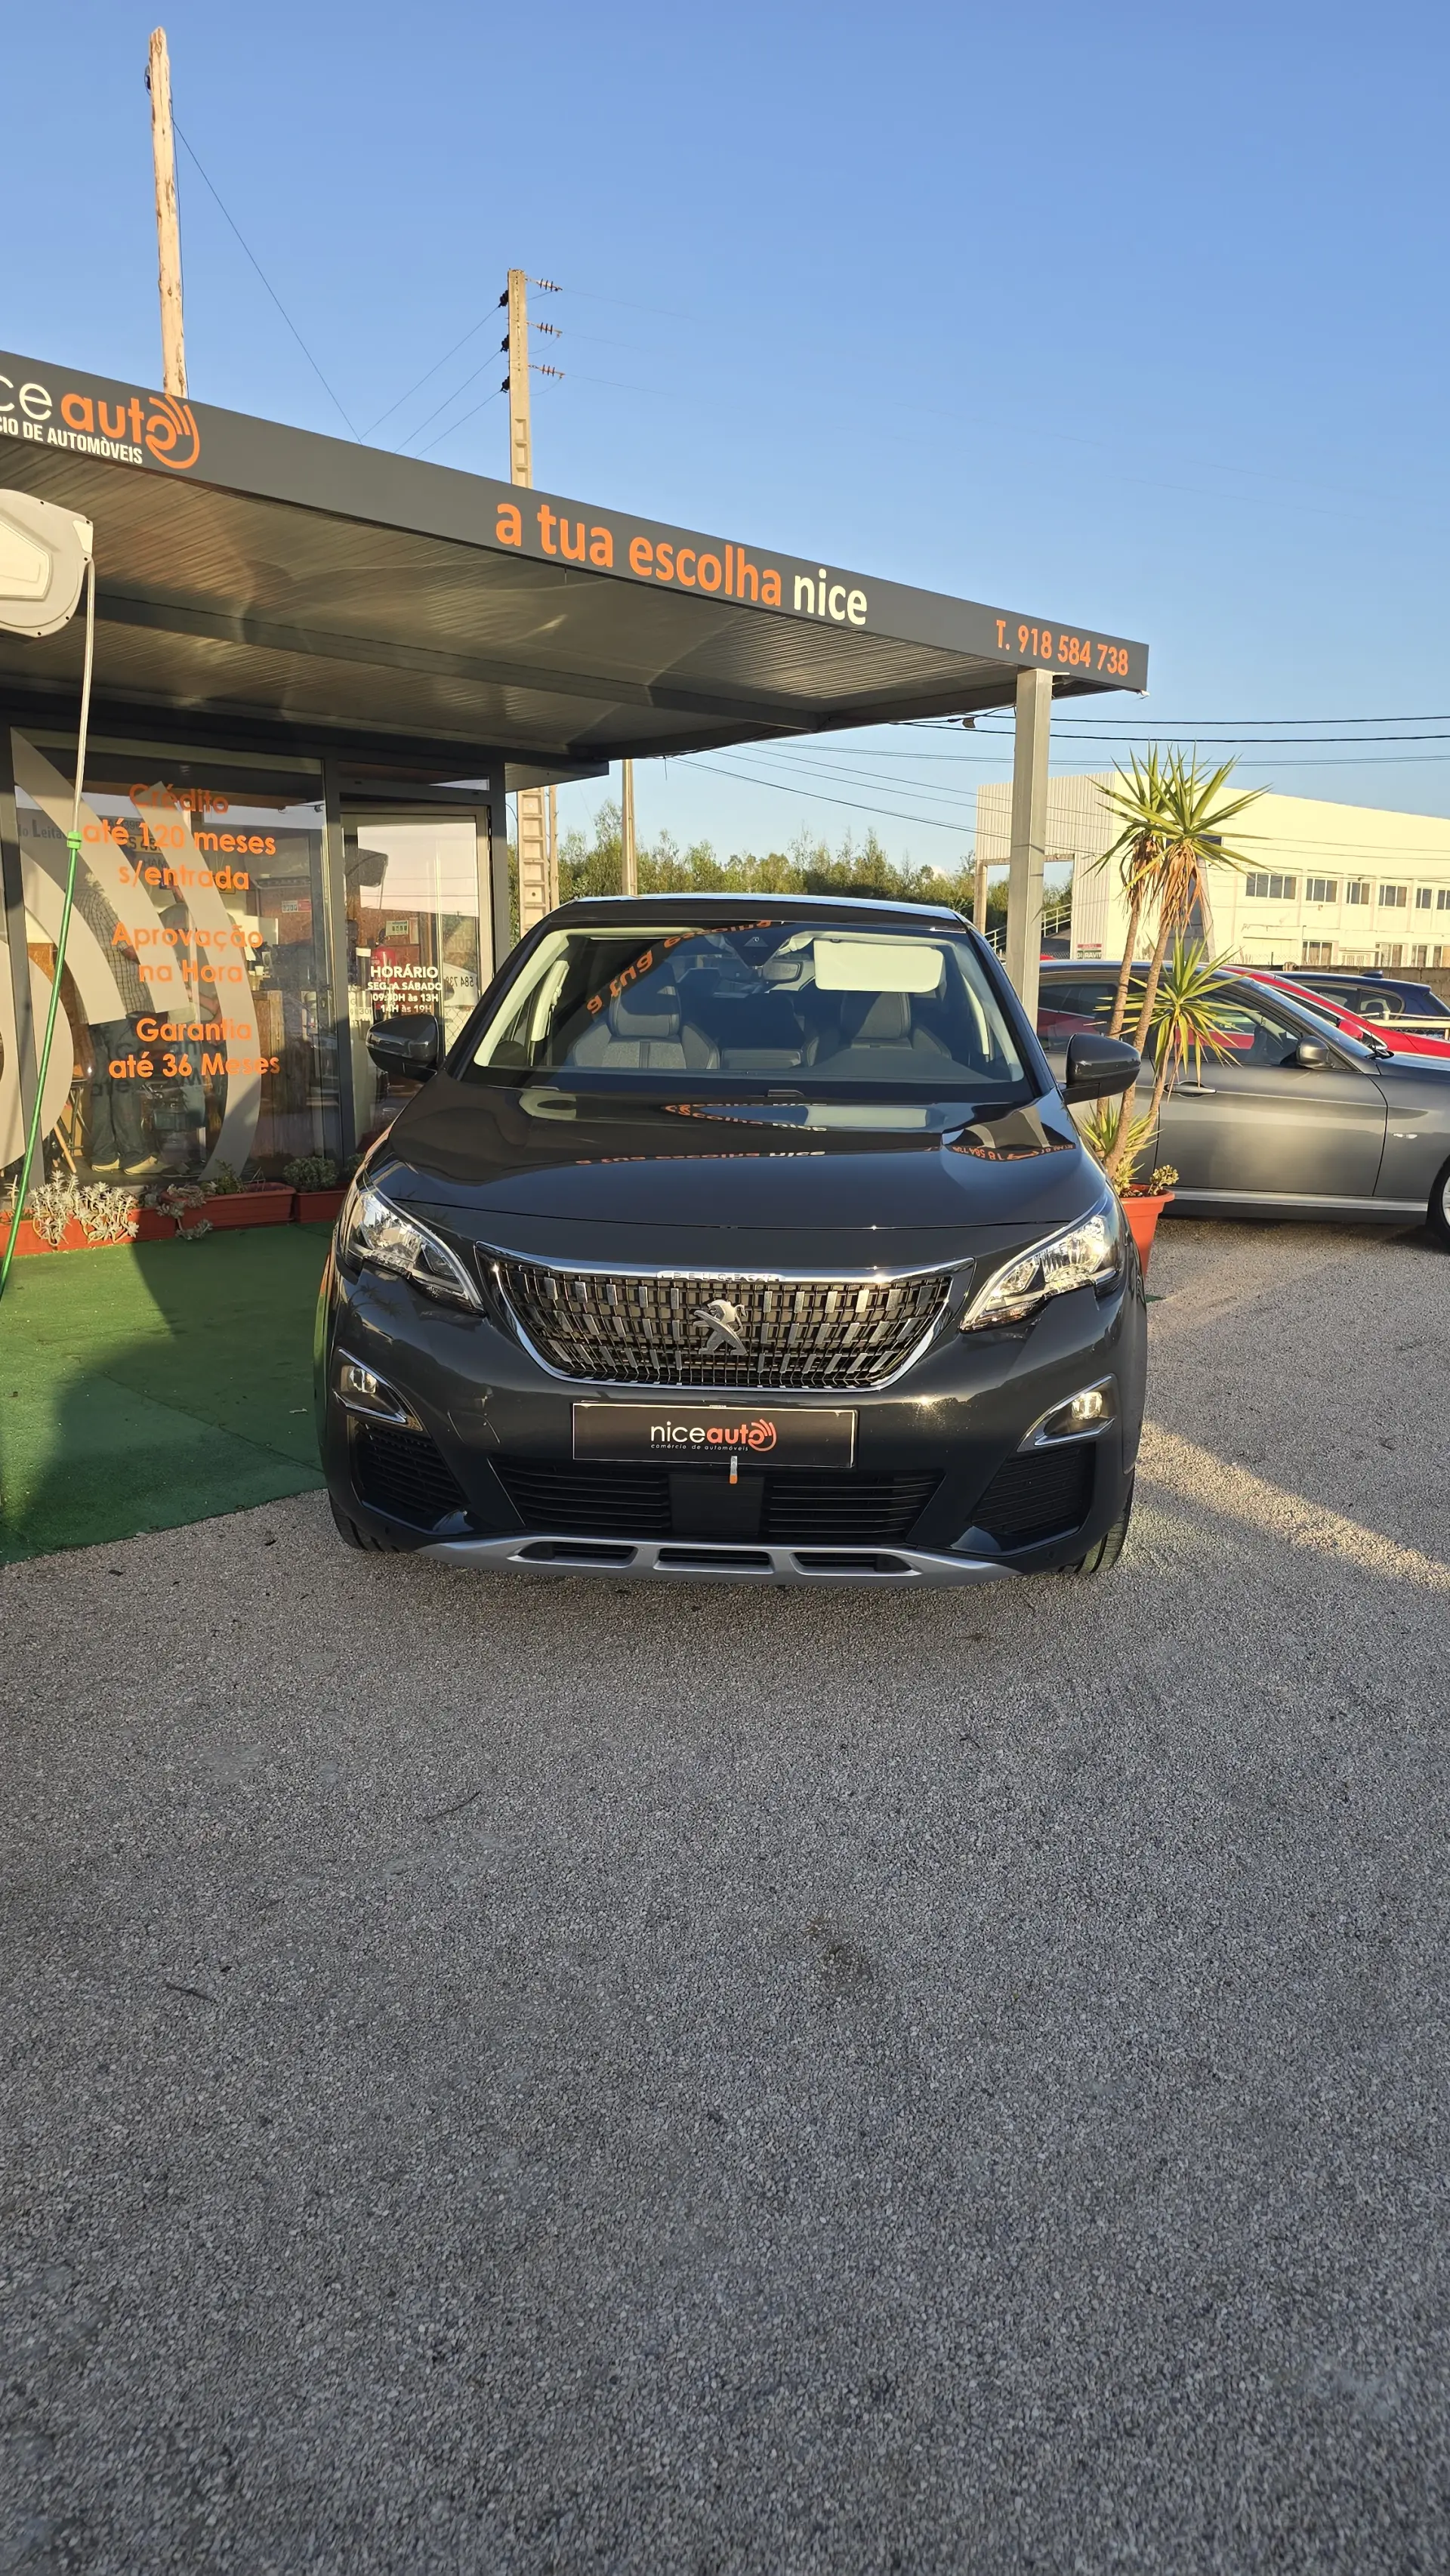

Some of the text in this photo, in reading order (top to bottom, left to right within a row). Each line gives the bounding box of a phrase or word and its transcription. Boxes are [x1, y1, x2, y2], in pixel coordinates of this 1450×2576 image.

[23, 421, 43, 442] DE
[496, 503, 868, 625] a tua escolha nice
[996, 619, 1129, 676] T. 918 584 738
[130, 783, 229, 814] Crédito
[83, 818, 129, 845] até
[139, 822, 185, 848] 120
[194, 831, 276, 855] meses
[119, 860, 250, 890] s/entrada
[111, 922, 263, 952] Aprovação
[139, 959, 243, 982] na Hora
[370, 963, 439, 979] HORÁRIO
[402, 981, 443, 990] SÁBADO
[408, 993, 418, 1002] às
[421, 993, 439, 1002] 13H
[414, 1004, 433, 1013] 19H
[137, 1018, 252, 1042] Garantia
[109, 1052, 280, 1079] até 36 Meses
